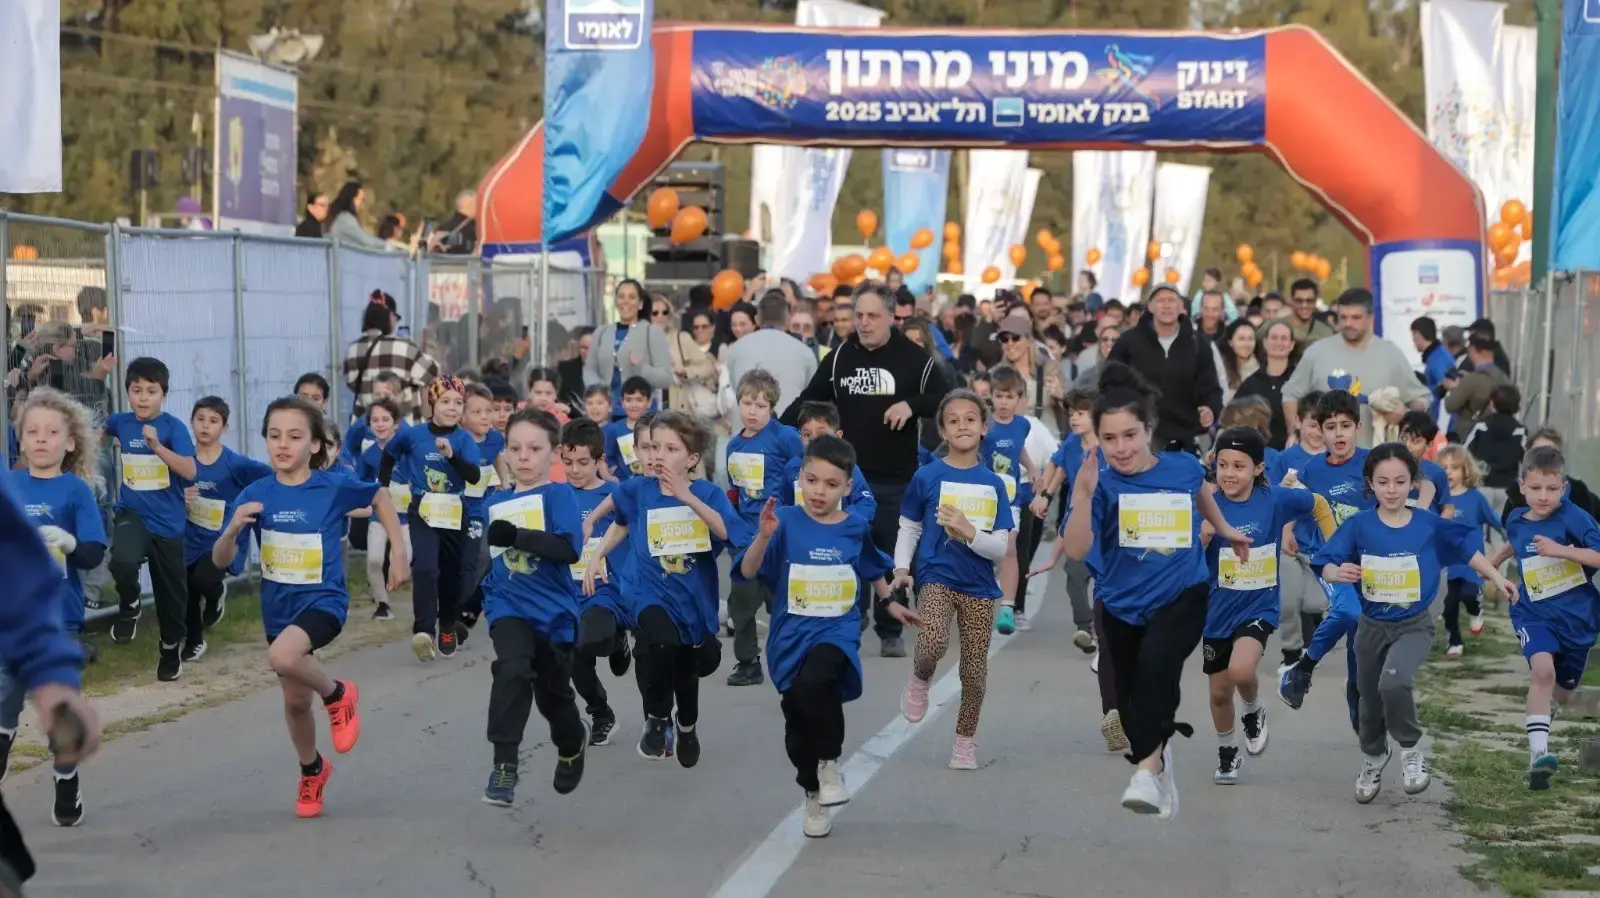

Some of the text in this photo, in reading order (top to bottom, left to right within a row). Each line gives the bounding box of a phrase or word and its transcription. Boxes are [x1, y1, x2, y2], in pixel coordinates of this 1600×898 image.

[577, 18, 633, 39] לאומי
[826, 49, 1090, 95] מיני מרתון
[1177, 60, 1249, 90] זינוק
[1177, 90, 1249, 109] START
[825, 101, 882, 121] 2025
[1028, 98, 1100, 124] לאומי
[1103, 102, 1150, 126] בנק
[840, 376, 876, 388] NORTH
[849, 385, 876, 395] FACE
